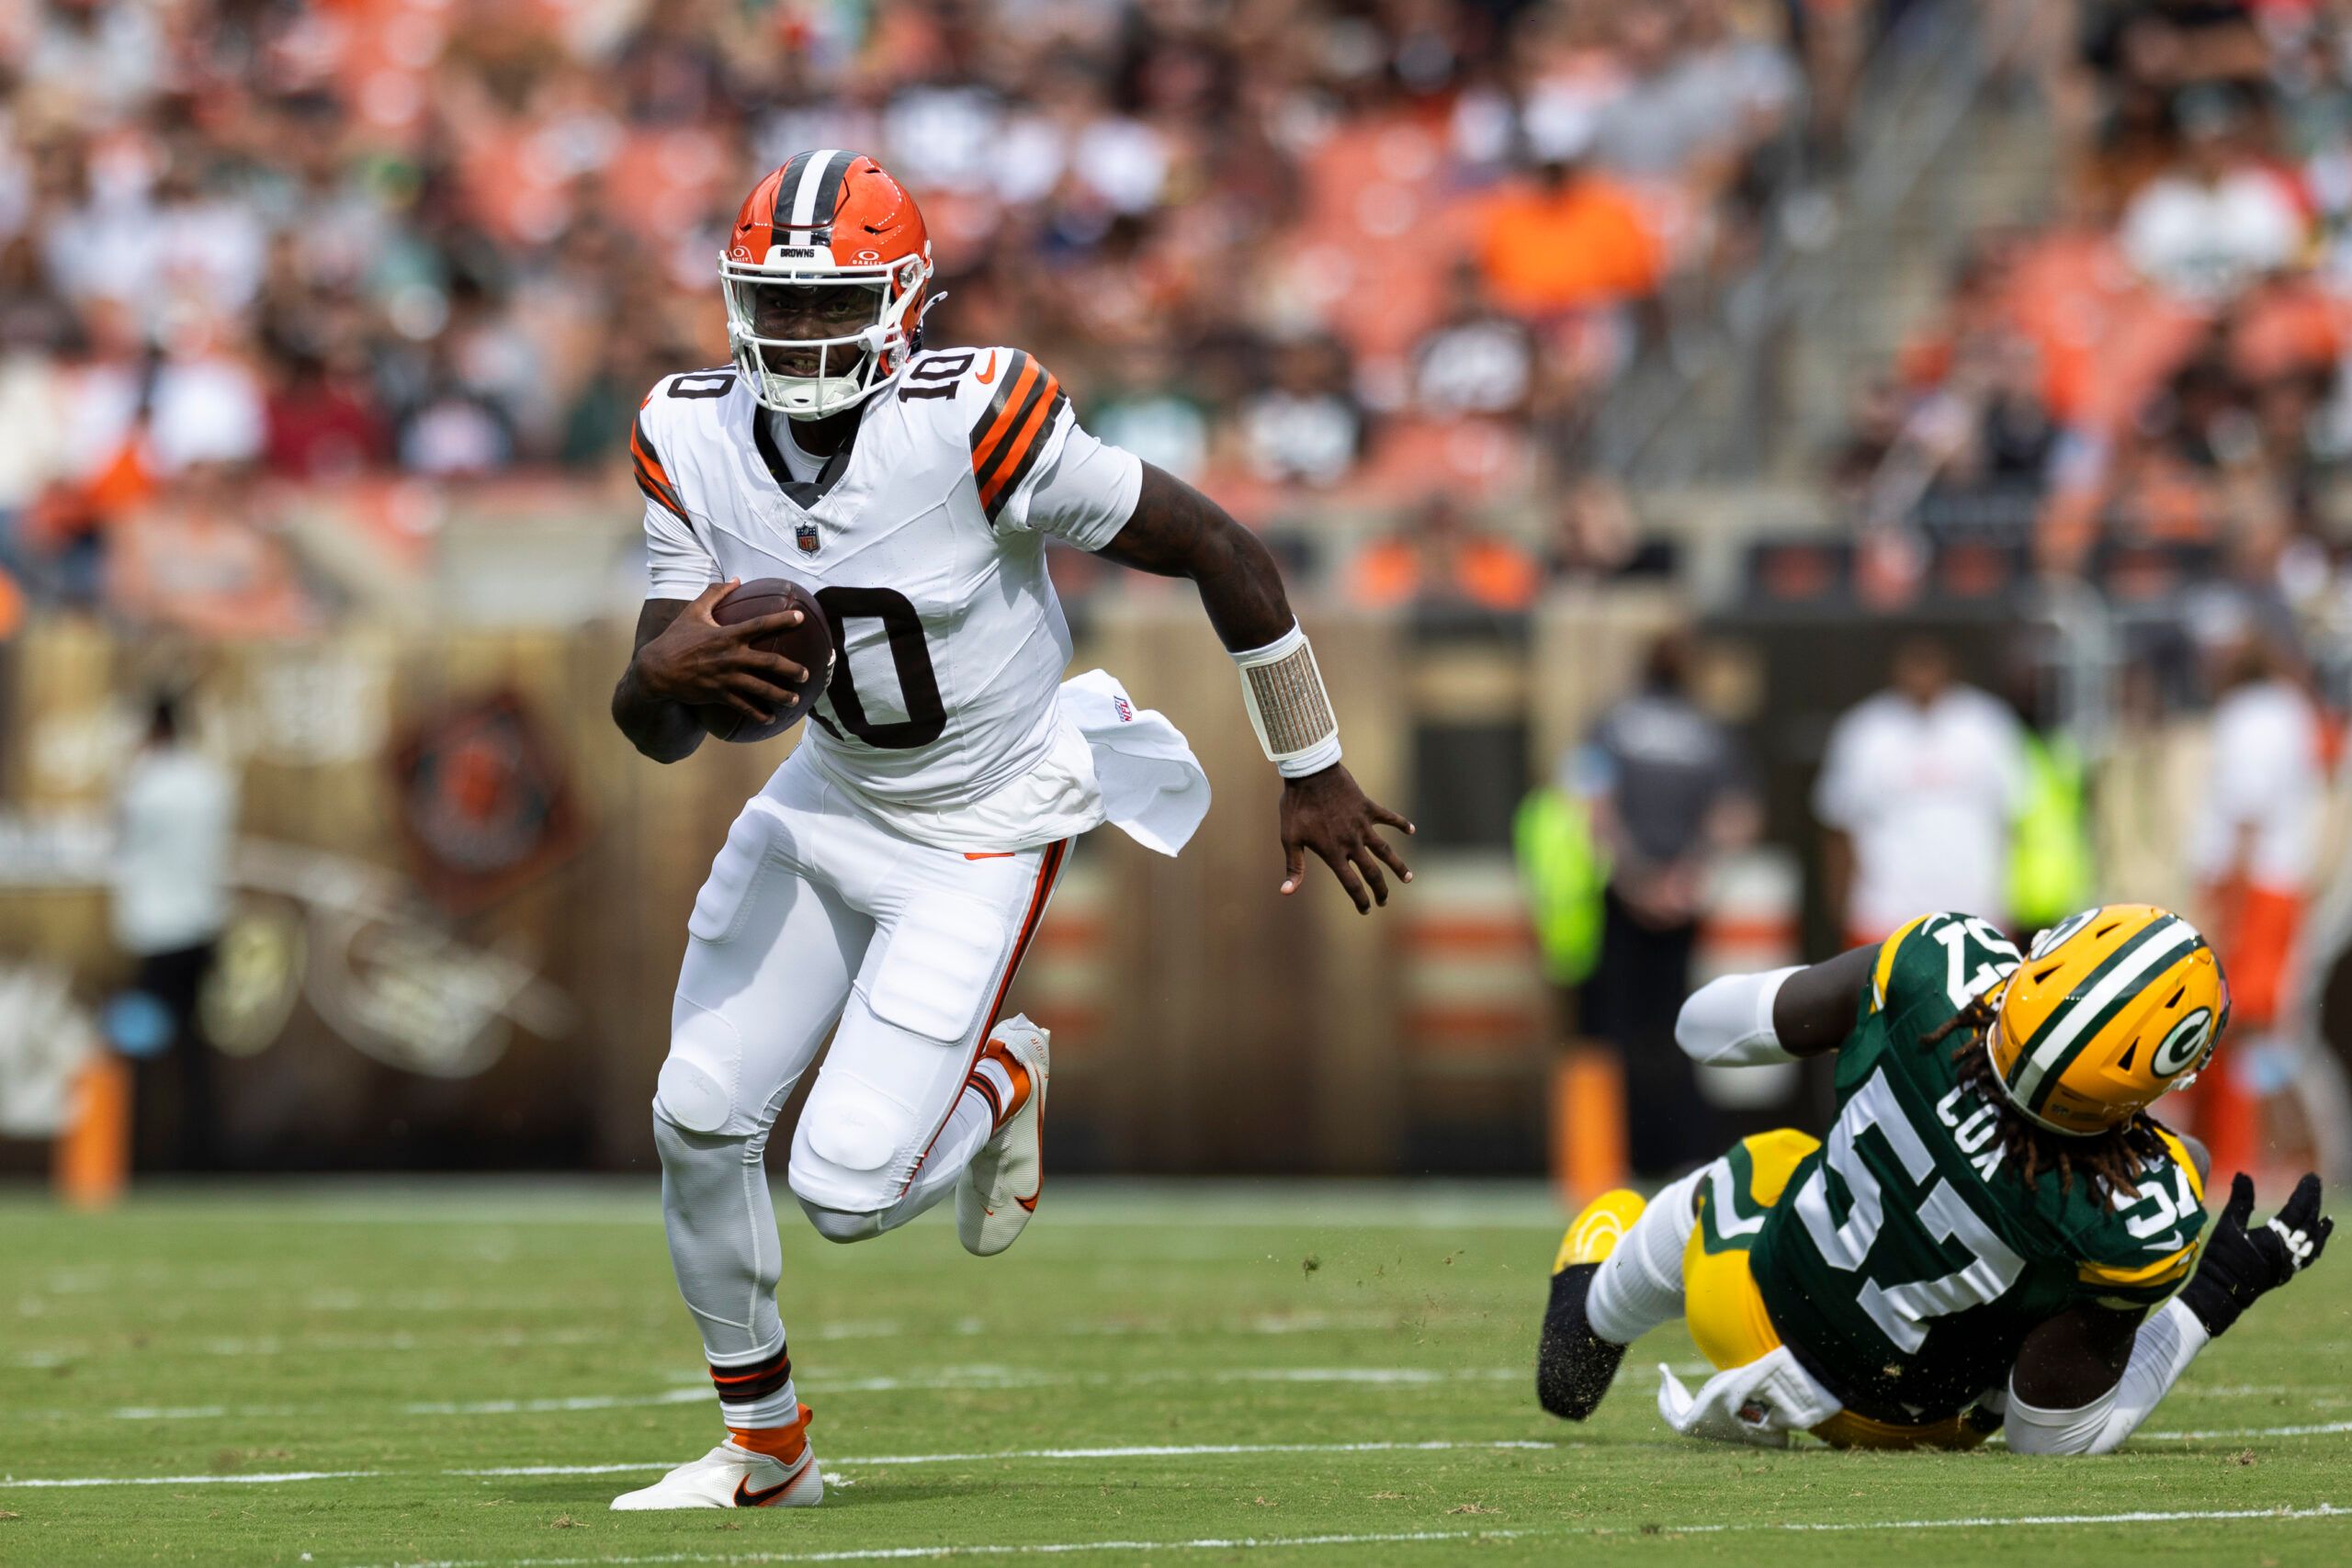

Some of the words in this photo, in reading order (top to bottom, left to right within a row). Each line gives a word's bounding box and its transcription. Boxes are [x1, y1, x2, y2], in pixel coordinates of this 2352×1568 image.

[780, 248, 815, 257] BROWNS
[898, 353, 975, 403] 10
[807, 586, 947, 750] 0
[1794, 1066, 2026, 1355] 57
